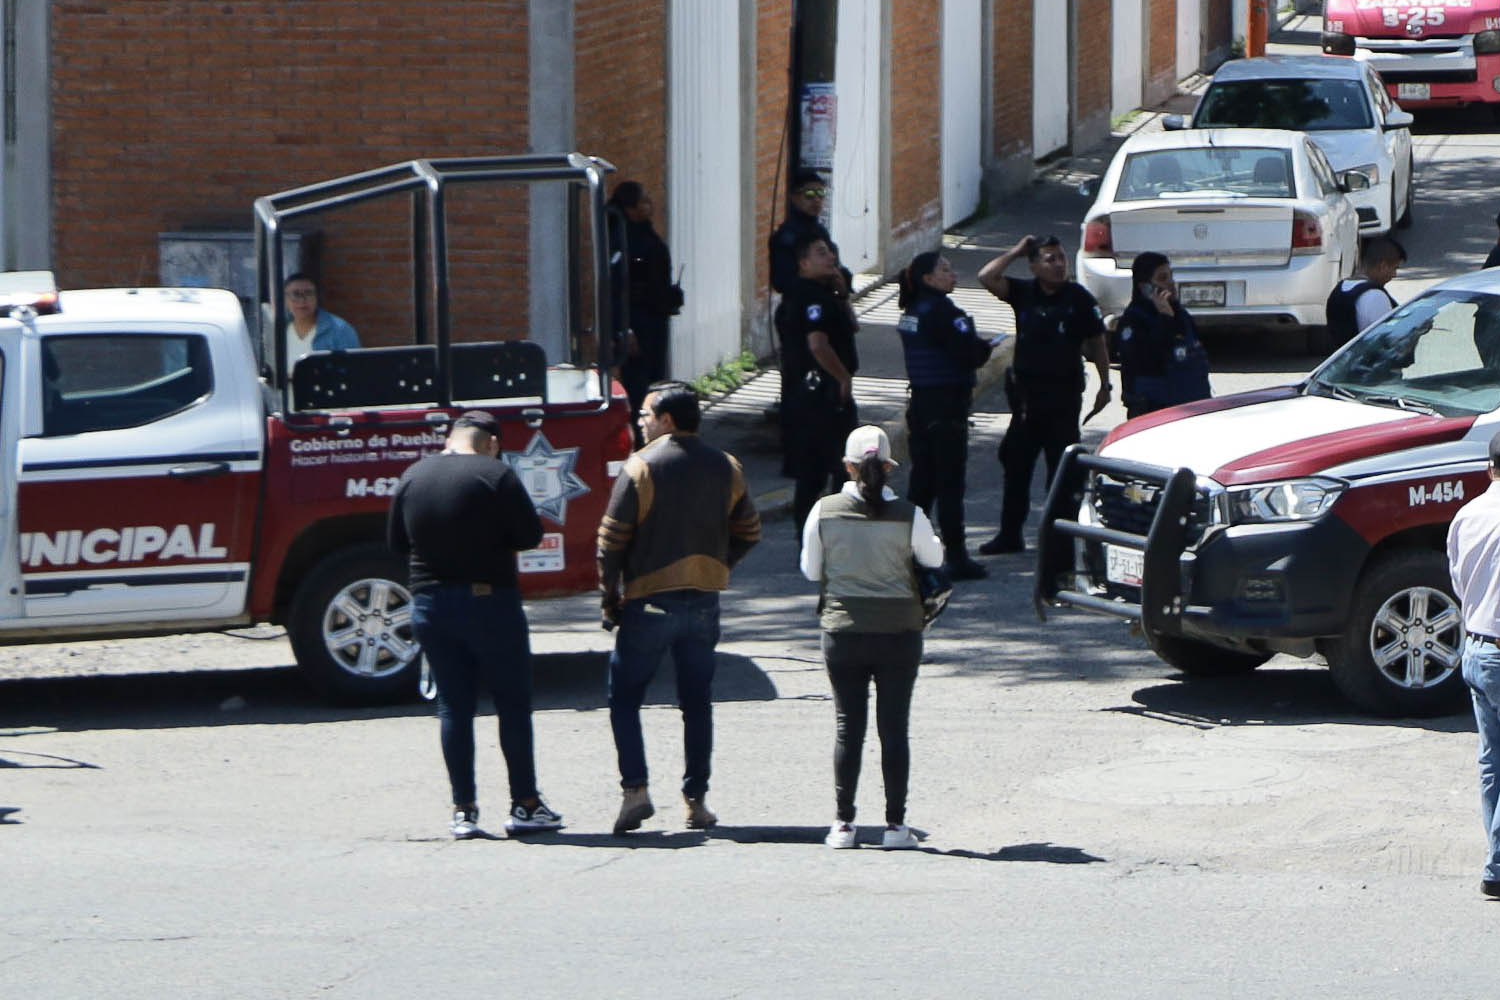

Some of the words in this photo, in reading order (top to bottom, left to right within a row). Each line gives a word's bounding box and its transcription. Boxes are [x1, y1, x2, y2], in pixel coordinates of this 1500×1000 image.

[290, 436, 364, 452] Gobierno
[368, 434, 389, 447] de
[391, 432, 446, 446] Puebla
[346, 476, 400, 497] M-62
[1408, 479, 1465, 506] M-454
